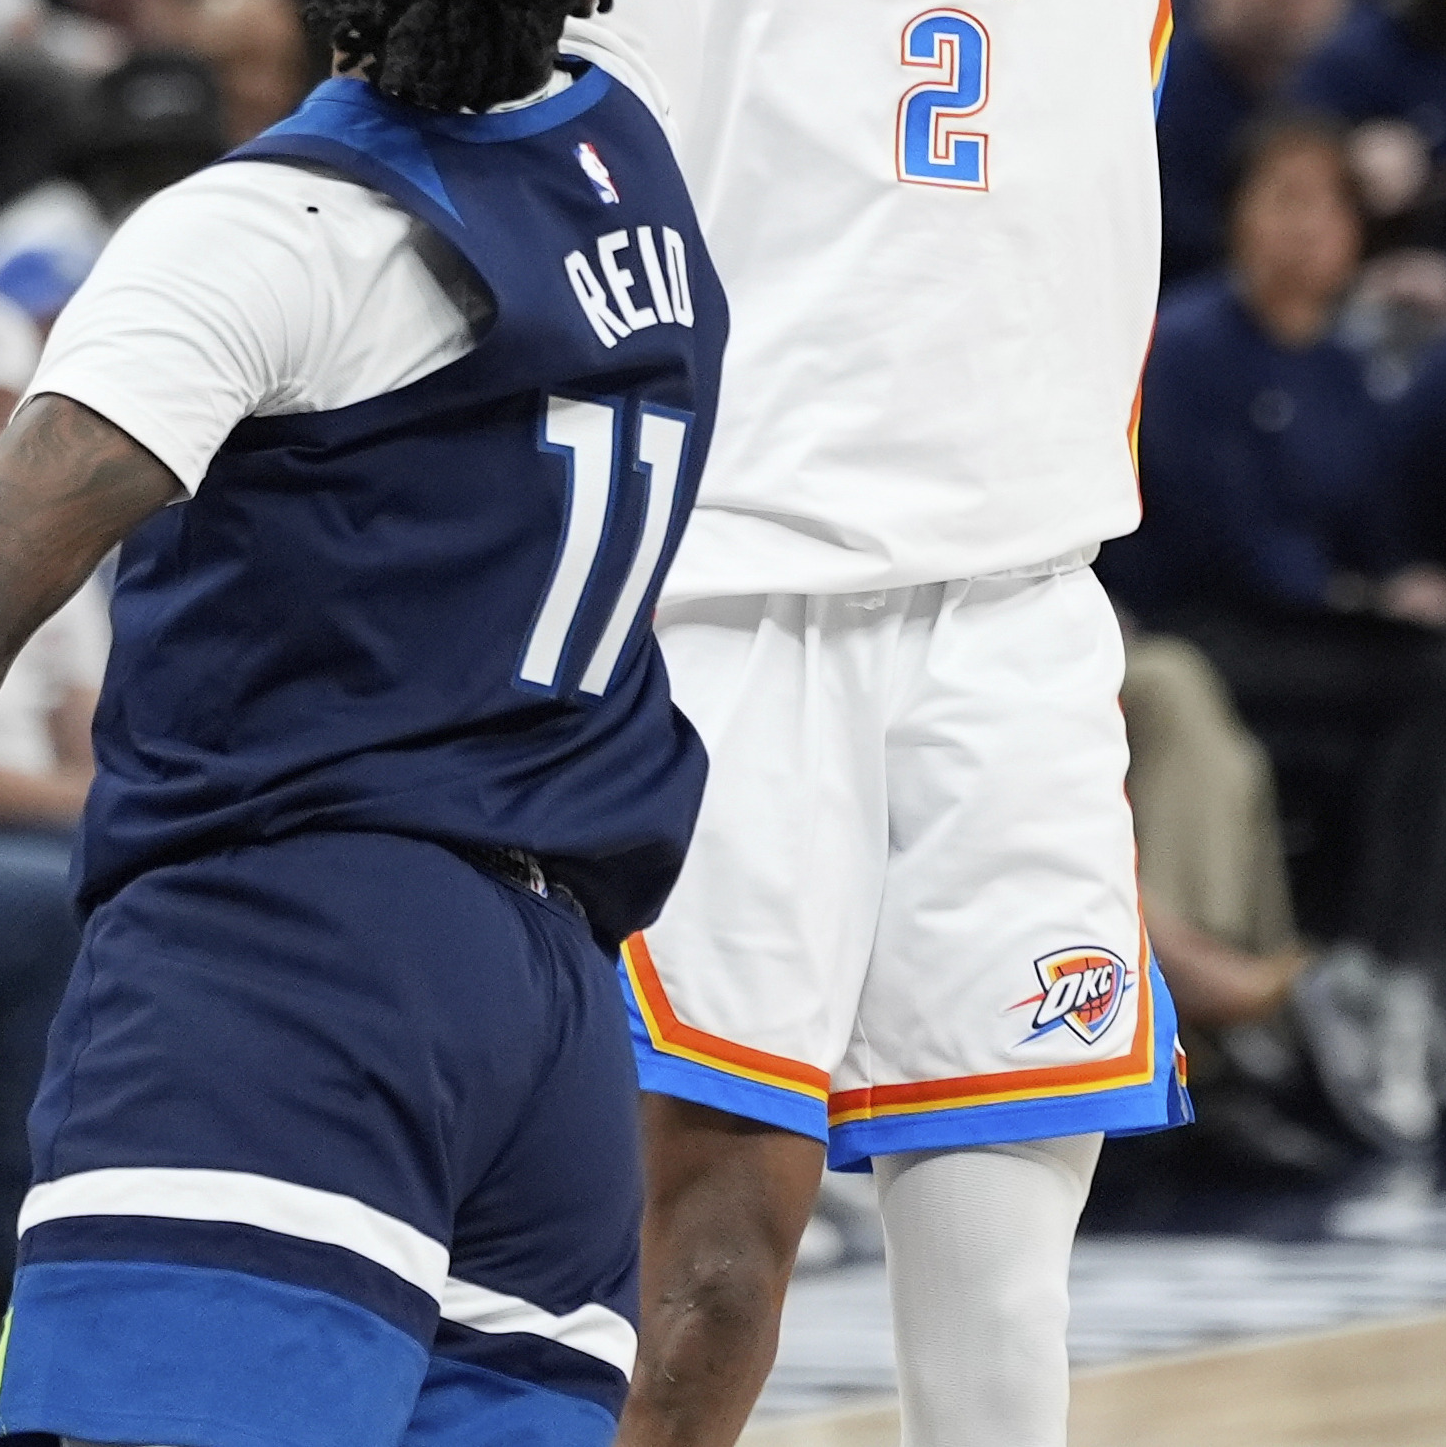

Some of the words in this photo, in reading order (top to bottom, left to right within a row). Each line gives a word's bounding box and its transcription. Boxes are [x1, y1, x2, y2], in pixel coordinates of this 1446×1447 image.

[896, 8, 990, 192] 2
[563, 224, 695, 350] REID
[513, 395, 695, 704] 11
[1033, 963, 1115, 1029] OKC
